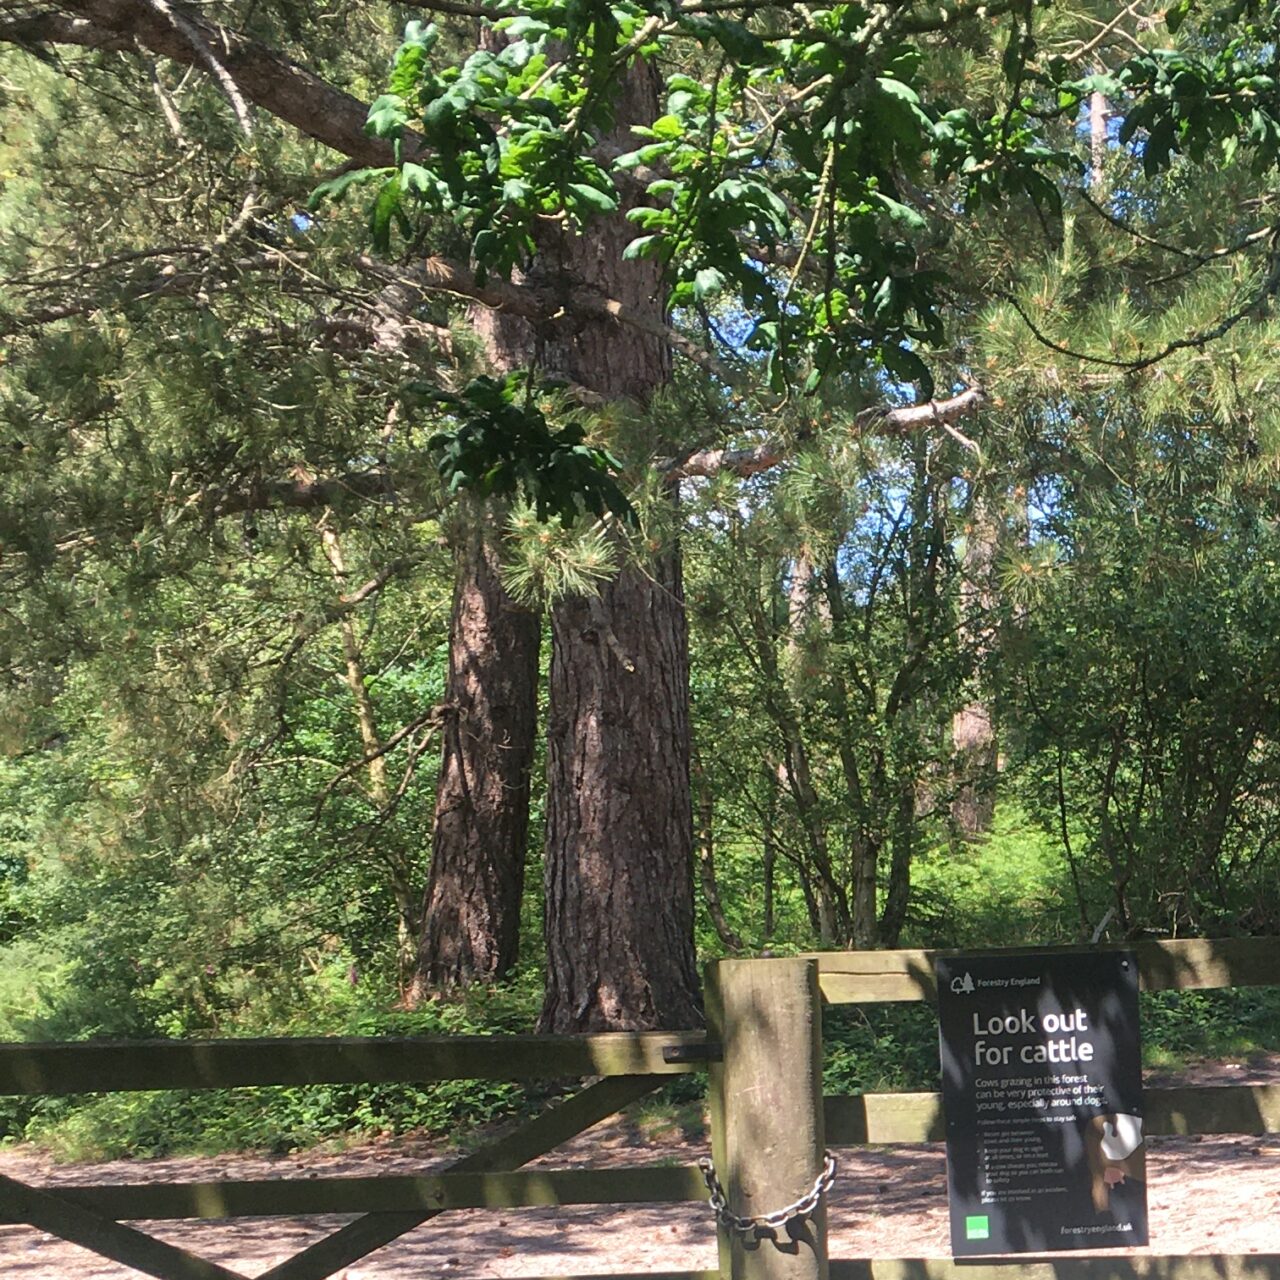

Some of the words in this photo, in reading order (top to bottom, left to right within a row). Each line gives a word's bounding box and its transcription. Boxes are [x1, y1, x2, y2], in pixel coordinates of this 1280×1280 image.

[977, 978, 1009, 989] Forestry
[1010, 976, 1040, 987] England
[973, 1008, 1037, 1035] Look
[1042, 1008, 1088, 1033] out
[975, 1040, 1013, 1066] for
[1020, 1036, 1094, 1064] cattle
[975, 1078, 999, 1088] Cows
[1000, 1078, 1032, 1089] grazing
[1034, 1076, 1042, 1085] in
[1044, 1075, 1060, 1084] this
[1061, 1074, 1088, 1084] forest
[976, 1091, 992, 1099] can
[993, 1089, 1006, 1098] be
[1006, 1090, 1027, 1099] very
[1028, 1086, 1071, 1098] protective
[1072, 1085, 1082, 1095] of
[1084, 1084, 1104, 1094] their
[1007, 1098, 1049, 1111] especially
[1051, 1097, 1083, 1106] around
[1060, 1222, 1133, 1235] forestryengland.uk
